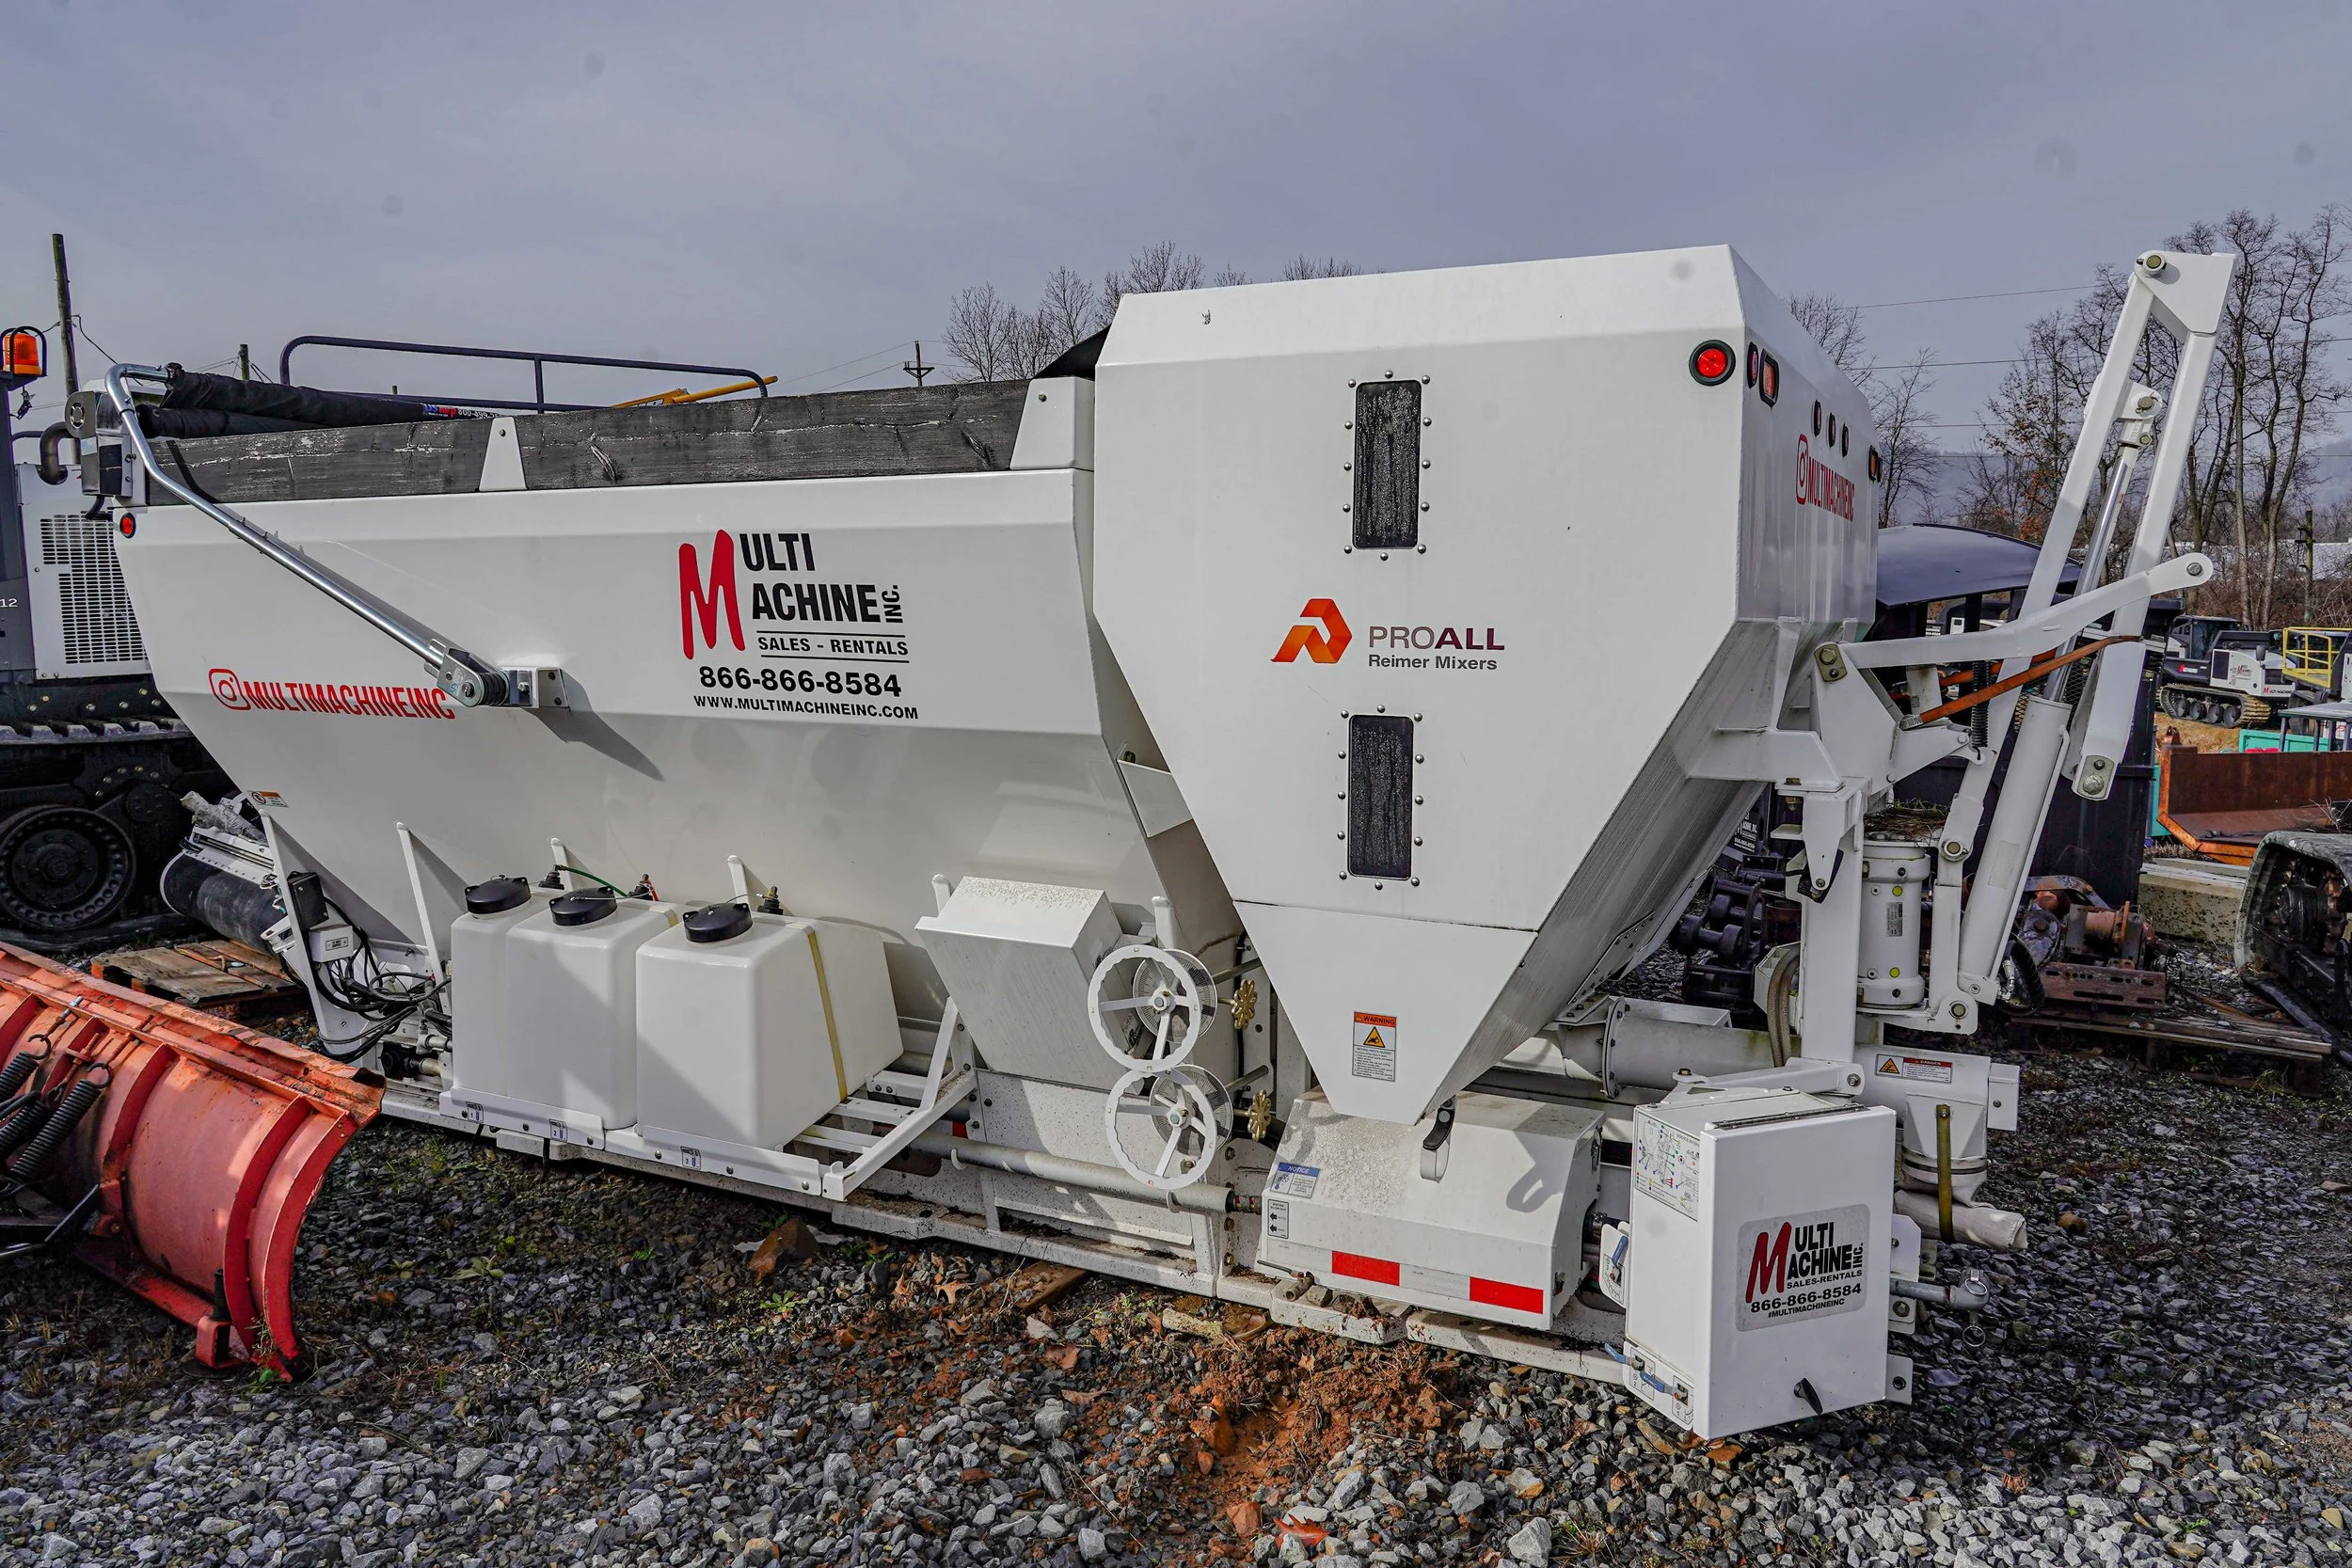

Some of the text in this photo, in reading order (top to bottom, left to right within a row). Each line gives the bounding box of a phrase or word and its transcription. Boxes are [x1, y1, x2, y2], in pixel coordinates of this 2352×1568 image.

[881, 584, 904, 624] INC.
[757, 636, 811, 652] SALES
[830, 639, 909, 656] RENTALS
[1368, 626, 1505, 651] PROALL
[1368, 654, 1498, 671] Reimer Mixers
[699, 665, 902, 698] 866-866-8584
[243, 681, 455, 720] MULTIMACHINEINC
[693, 695, 919, 720] WWW.MULTIMACHINEINC.COM
[1363, 1015, 1395, 1025] WARNING
[1287, 1165, 1311, 1175] NOTICE
[1851, 1242, 1864, 1269] INC.
[1787, 1270, 1863, 1290] SALES-RENTALS
[1750, 1283, 1862, 1313] 866-866-8584
